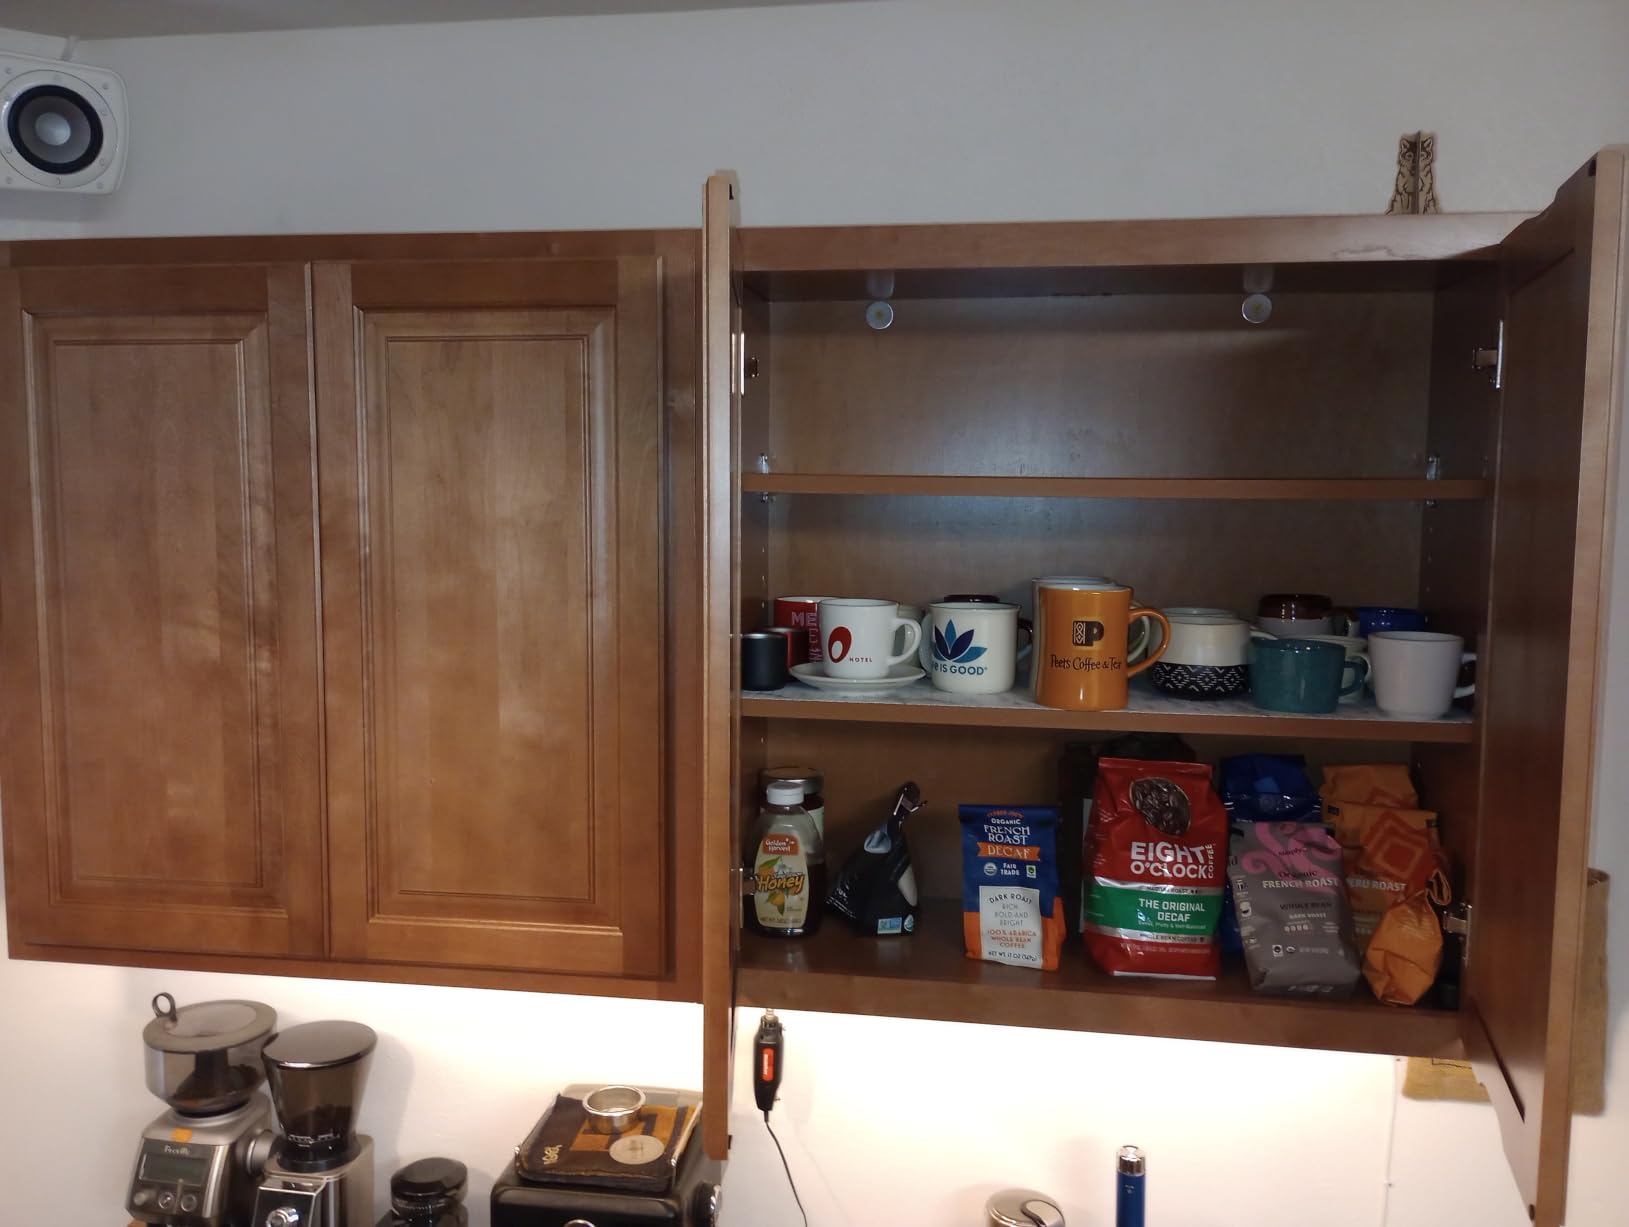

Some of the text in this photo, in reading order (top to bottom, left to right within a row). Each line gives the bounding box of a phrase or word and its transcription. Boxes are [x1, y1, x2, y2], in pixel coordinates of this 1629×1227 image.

[949, 665, 985, 676] GOOD
[1072, 656, 1101, 672] Coffee
[1109, 656, 1122, 670] Tea
[991, 817, 1022, 825] ORGANIC
[984, 824, 1031, 836] FRENCH
[988, 833, 1028, 846] ROAST
[988, 845, 1030, 859] DECAF
[1131, 841, 1205, 864] EIGHT
[1205, 843, 1214, 879] COFFEE
[1130, 861, 1208, 879] O'CLOCK
[757, 875, 805, 893] Honey
[1262, 877, 1340, 889] FRENCH ROAST
[1371, 879, 1408, 892] ROAST
[989, 893, 1032, 904] DARK ROAST
[1138, 898, 1206, 912] THE ORIGINAL
[1157, 911, 1191, 922] DECAF
